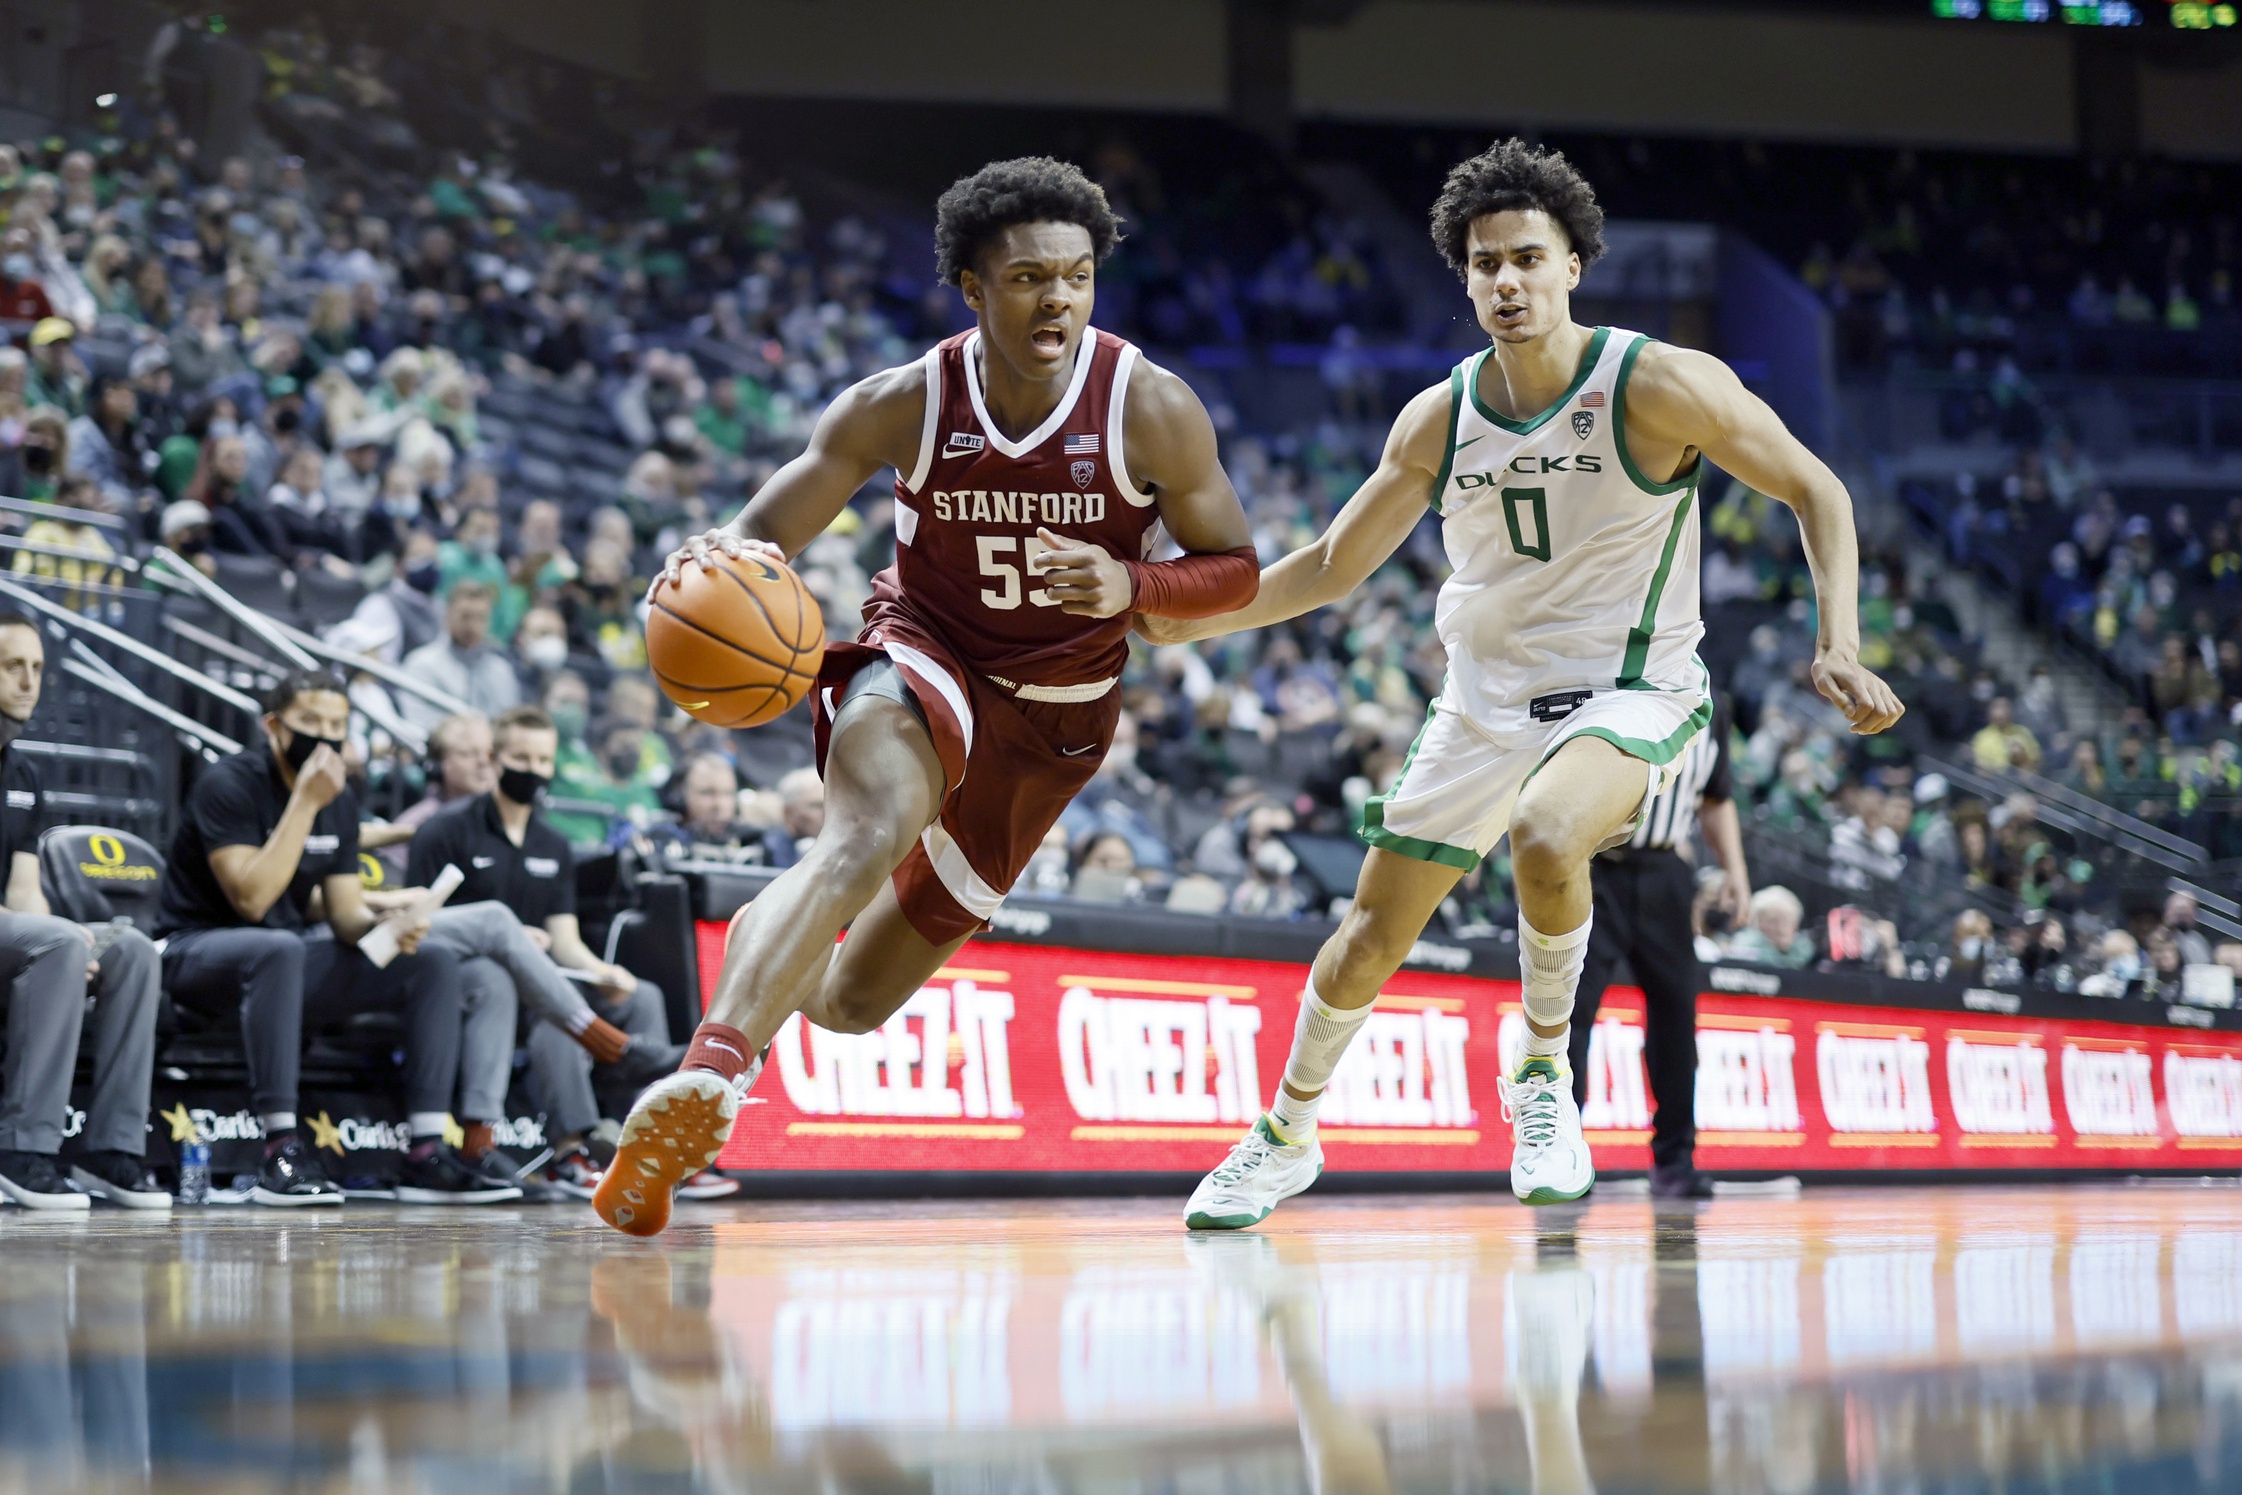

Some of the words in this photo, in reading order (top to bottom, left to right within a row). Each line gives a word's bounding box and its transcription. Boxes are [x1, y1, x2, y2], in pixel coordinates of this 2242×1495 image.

[1577, 423, 1588, 433] 12
[1077, 473, 1088, 483] 12
[1455, 455, 1602, 490] DUCKS
[933, 490, 1105, 524] STANFORD
[1501, 487, 1551, 562] 0
